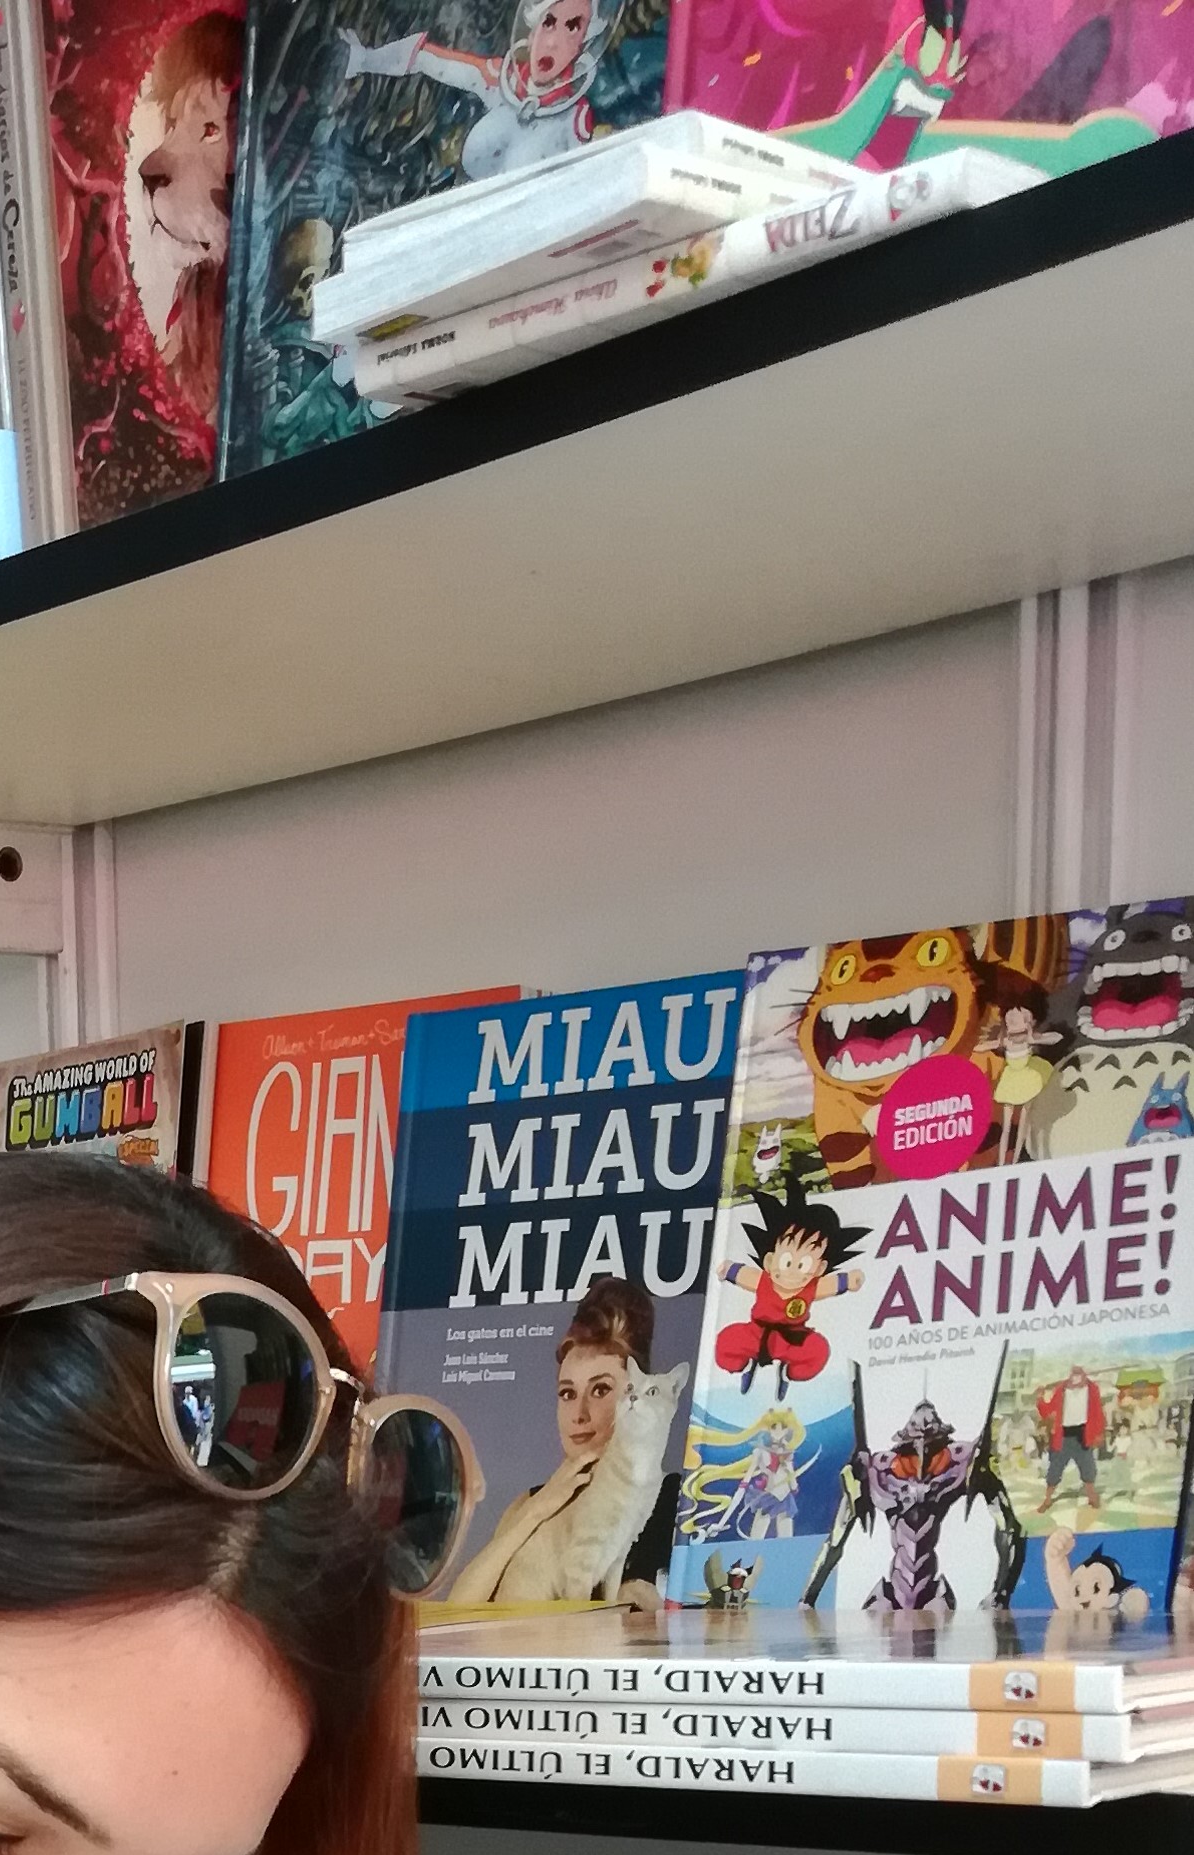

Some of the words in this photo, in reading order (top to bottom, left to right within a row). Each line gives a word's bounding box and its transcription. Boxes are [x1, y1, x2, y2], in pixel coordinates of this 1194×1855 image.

[3, 170, 13, 195] de
[2, 199, 20, 293] Cereza
[468, 988, 736, 1104] MIAU
[33, 1063, 94, 1095] AMAZING
[94, 1054, 137, 1084] WORLD
[138, 1049, 156, 1074] OF
[8, 1073, 157, 1147] GUMBALL
[894, 1093, 974, 1128] SEGUNDA
[246, 1050, 406, 1238] GIAN
[893, 1113, 974, 1152] EDICIÓN
[458, 1098, 725, 1207] MIAU
[875, 1153, 1182, 1259] ANIME!
[448, 1207, 714, 1309] MIAU
[868, 1229, 1175, 1331] ANIME!
[446, 1327, 466, 1341] Los
[467, 1326, 498, 1343] gatos
[499, 1327, 514, 1338] en
[516, 1324, 527, 1338] el
[528, 1323, 554, 1337] cine
[868, 1334, 893, 1350] 100
[896, 1325, 943, 1347] AÑOS
[947, 1325, 968, 1342] DE
[973, 1312, 1075, 1339] ANIMACIÓN
[1077, 1302, 1171, 1327] JAPONESA
[455, 1666, 590, 1697] ÚLTIMO
[603, 1668, 640, 1691] EL
[654, 1665, 825, 1696] HARALD,
[464, 1707, 598, 1739] ÚLTIMO
[612, 1711, 648, 1735] EL
[661, 1708, 833, 1740] HARALD,
[429, 1746, 563, 1780] ÚLTIMO
[576, 1752, 611, 1776] EL
[625, 1750, 794, 1784] HARALD,
